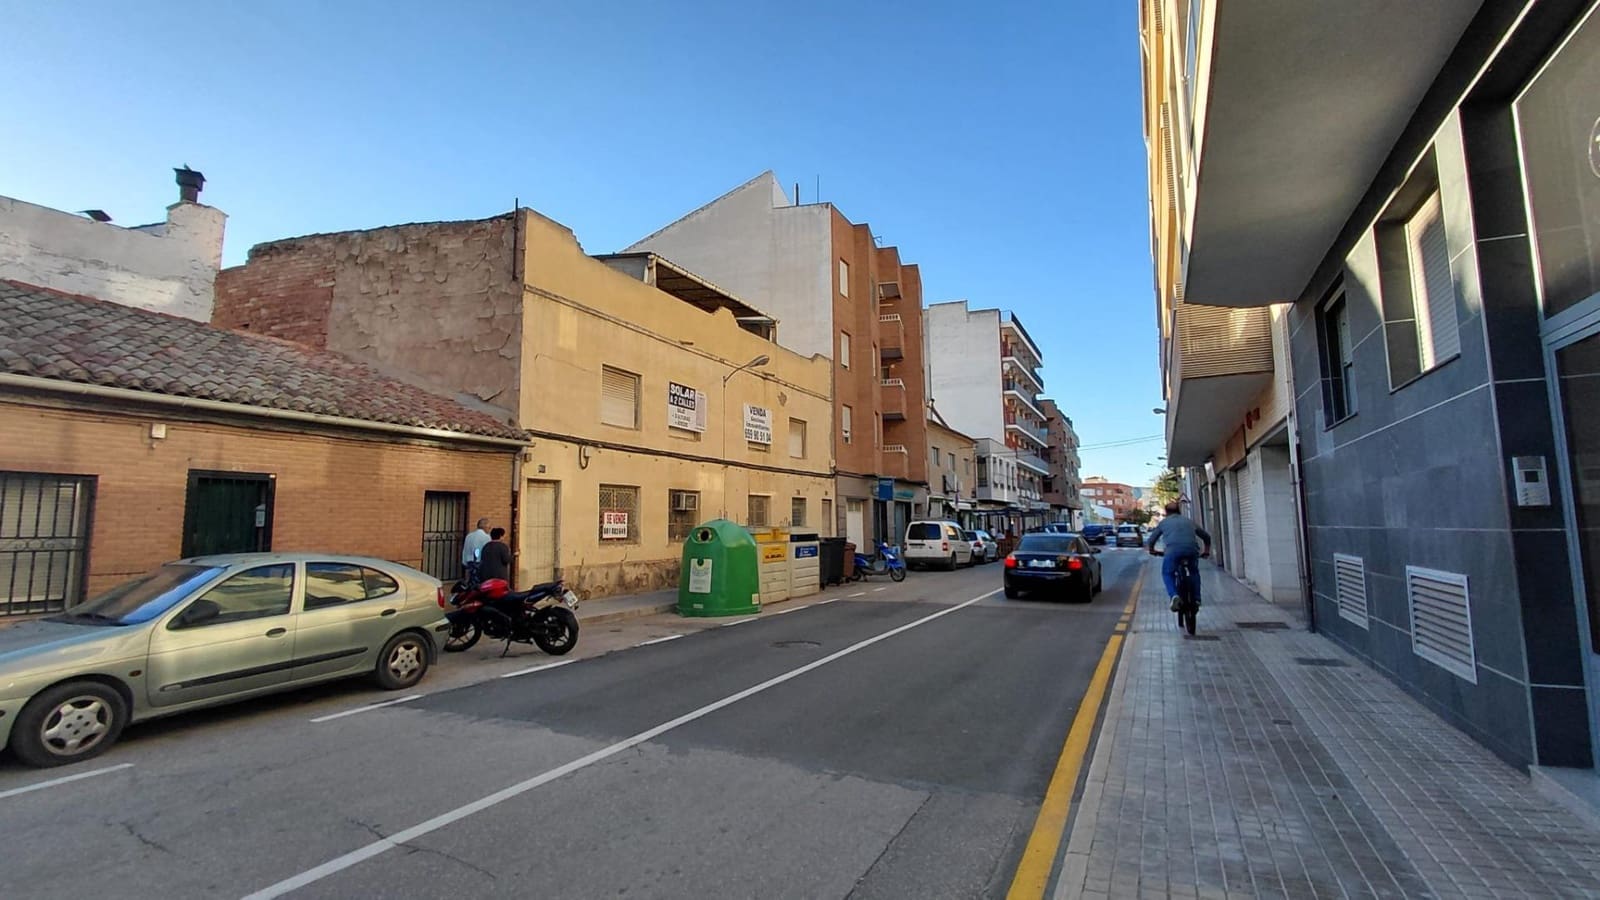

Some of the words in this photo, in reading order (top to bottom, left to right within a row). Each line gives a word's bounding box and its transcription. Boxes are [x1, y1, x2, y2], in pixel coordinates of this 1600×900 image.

[670, 383, 695, 400] SOLAR
[749, 405, 766, 417] VENDA
[607, 514, 612, 524] SE
[613, 514, 626, 524] VENDE
